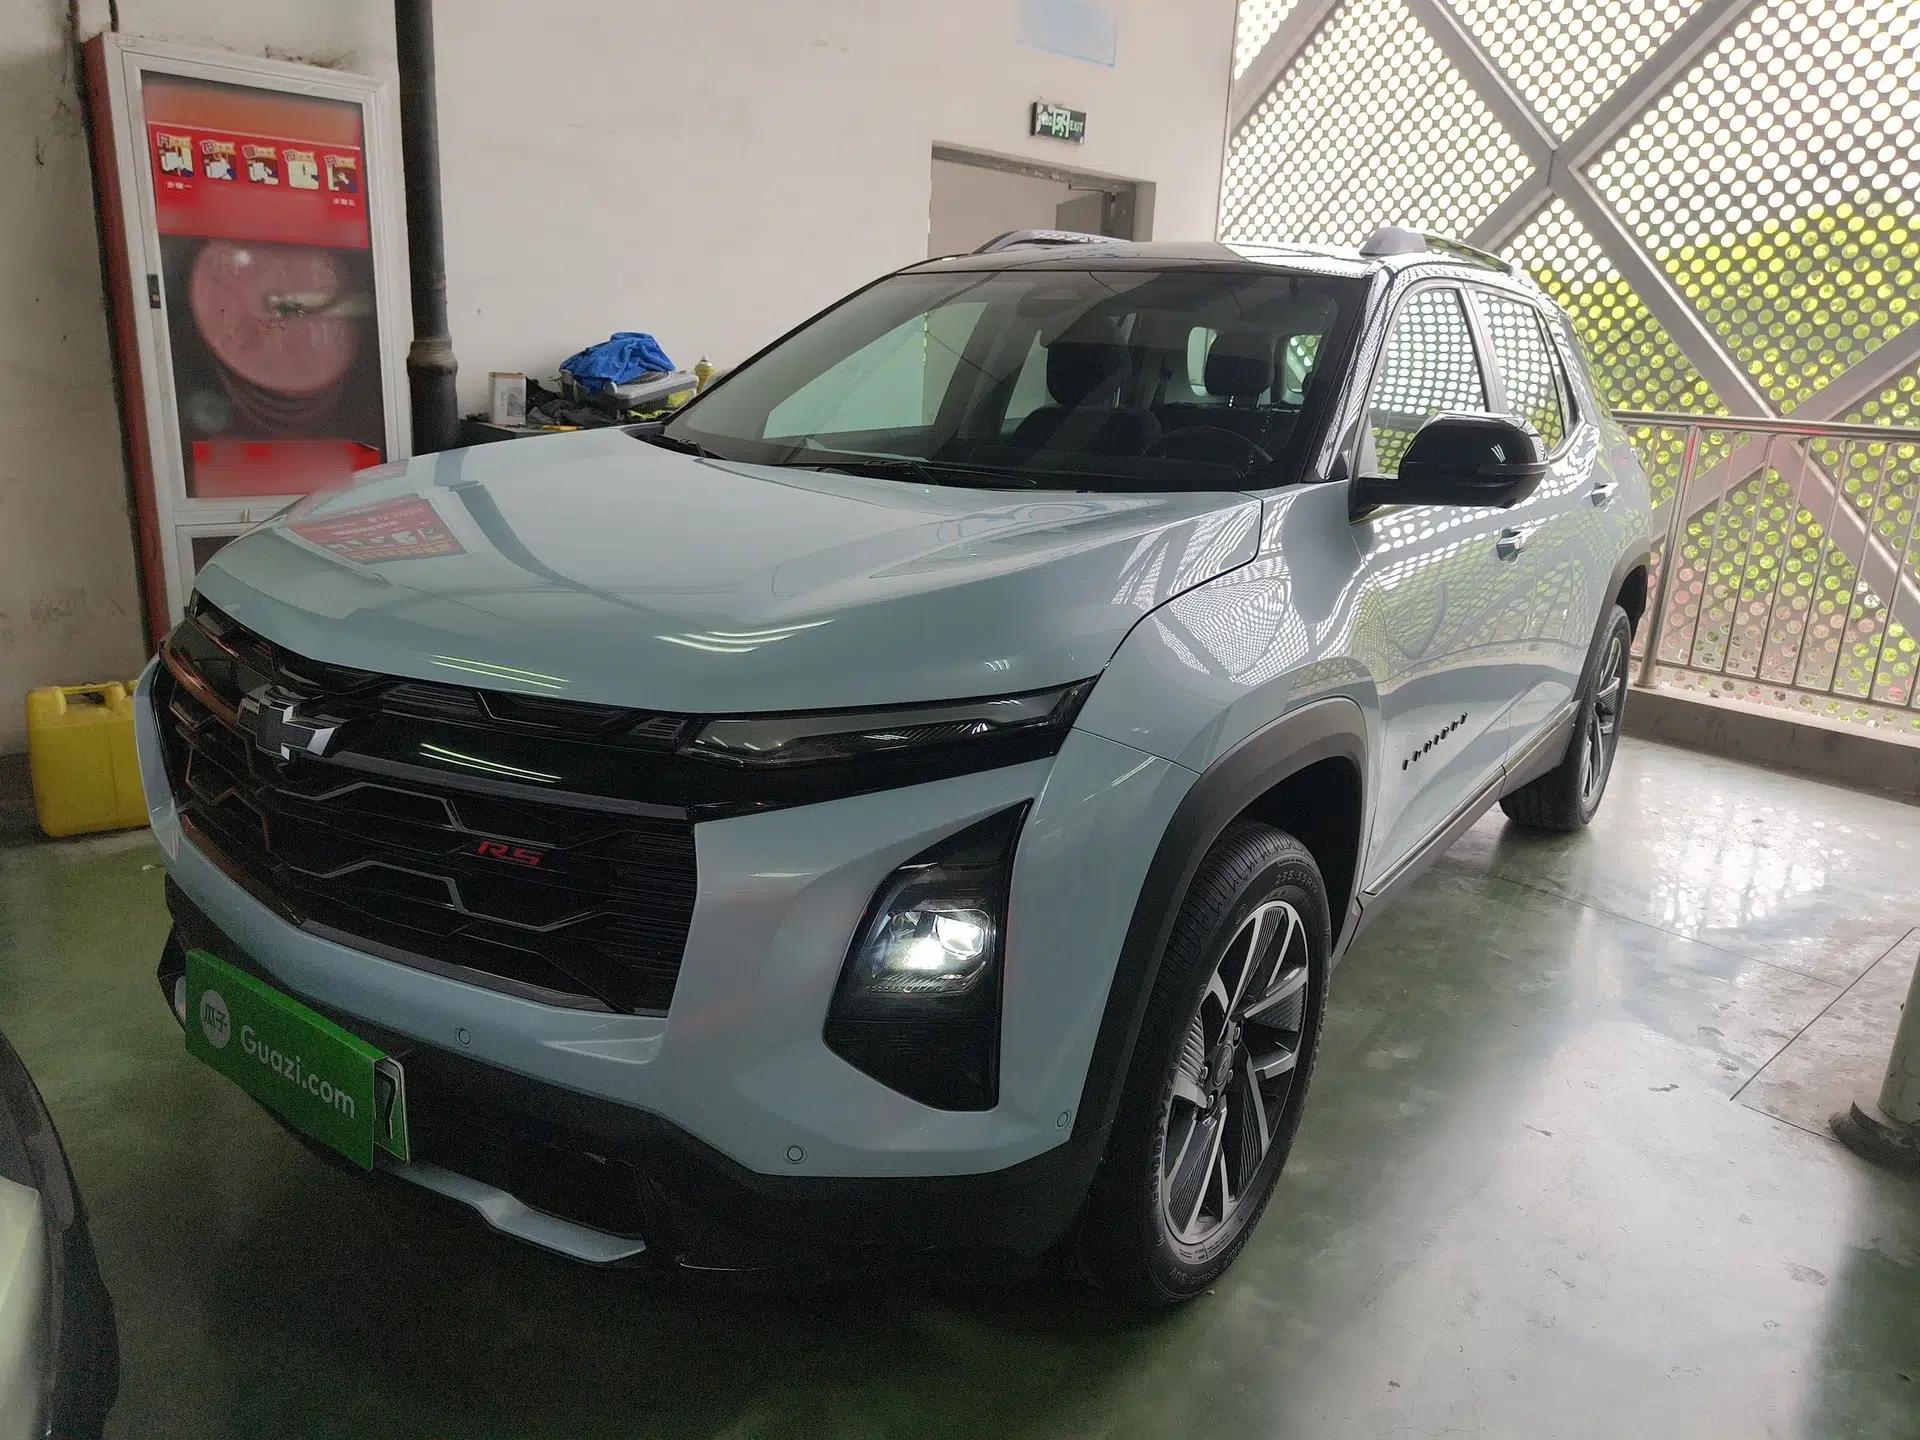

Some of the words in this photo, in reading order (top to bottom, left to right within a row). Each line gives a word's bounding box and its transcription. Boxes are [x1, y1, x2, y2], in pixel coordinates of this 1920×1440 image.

[1070, 120, 1083, 132] EXIT
[478, 840, 544, 866] RS
[240, 1024, 355, 1119] Guazi.com
